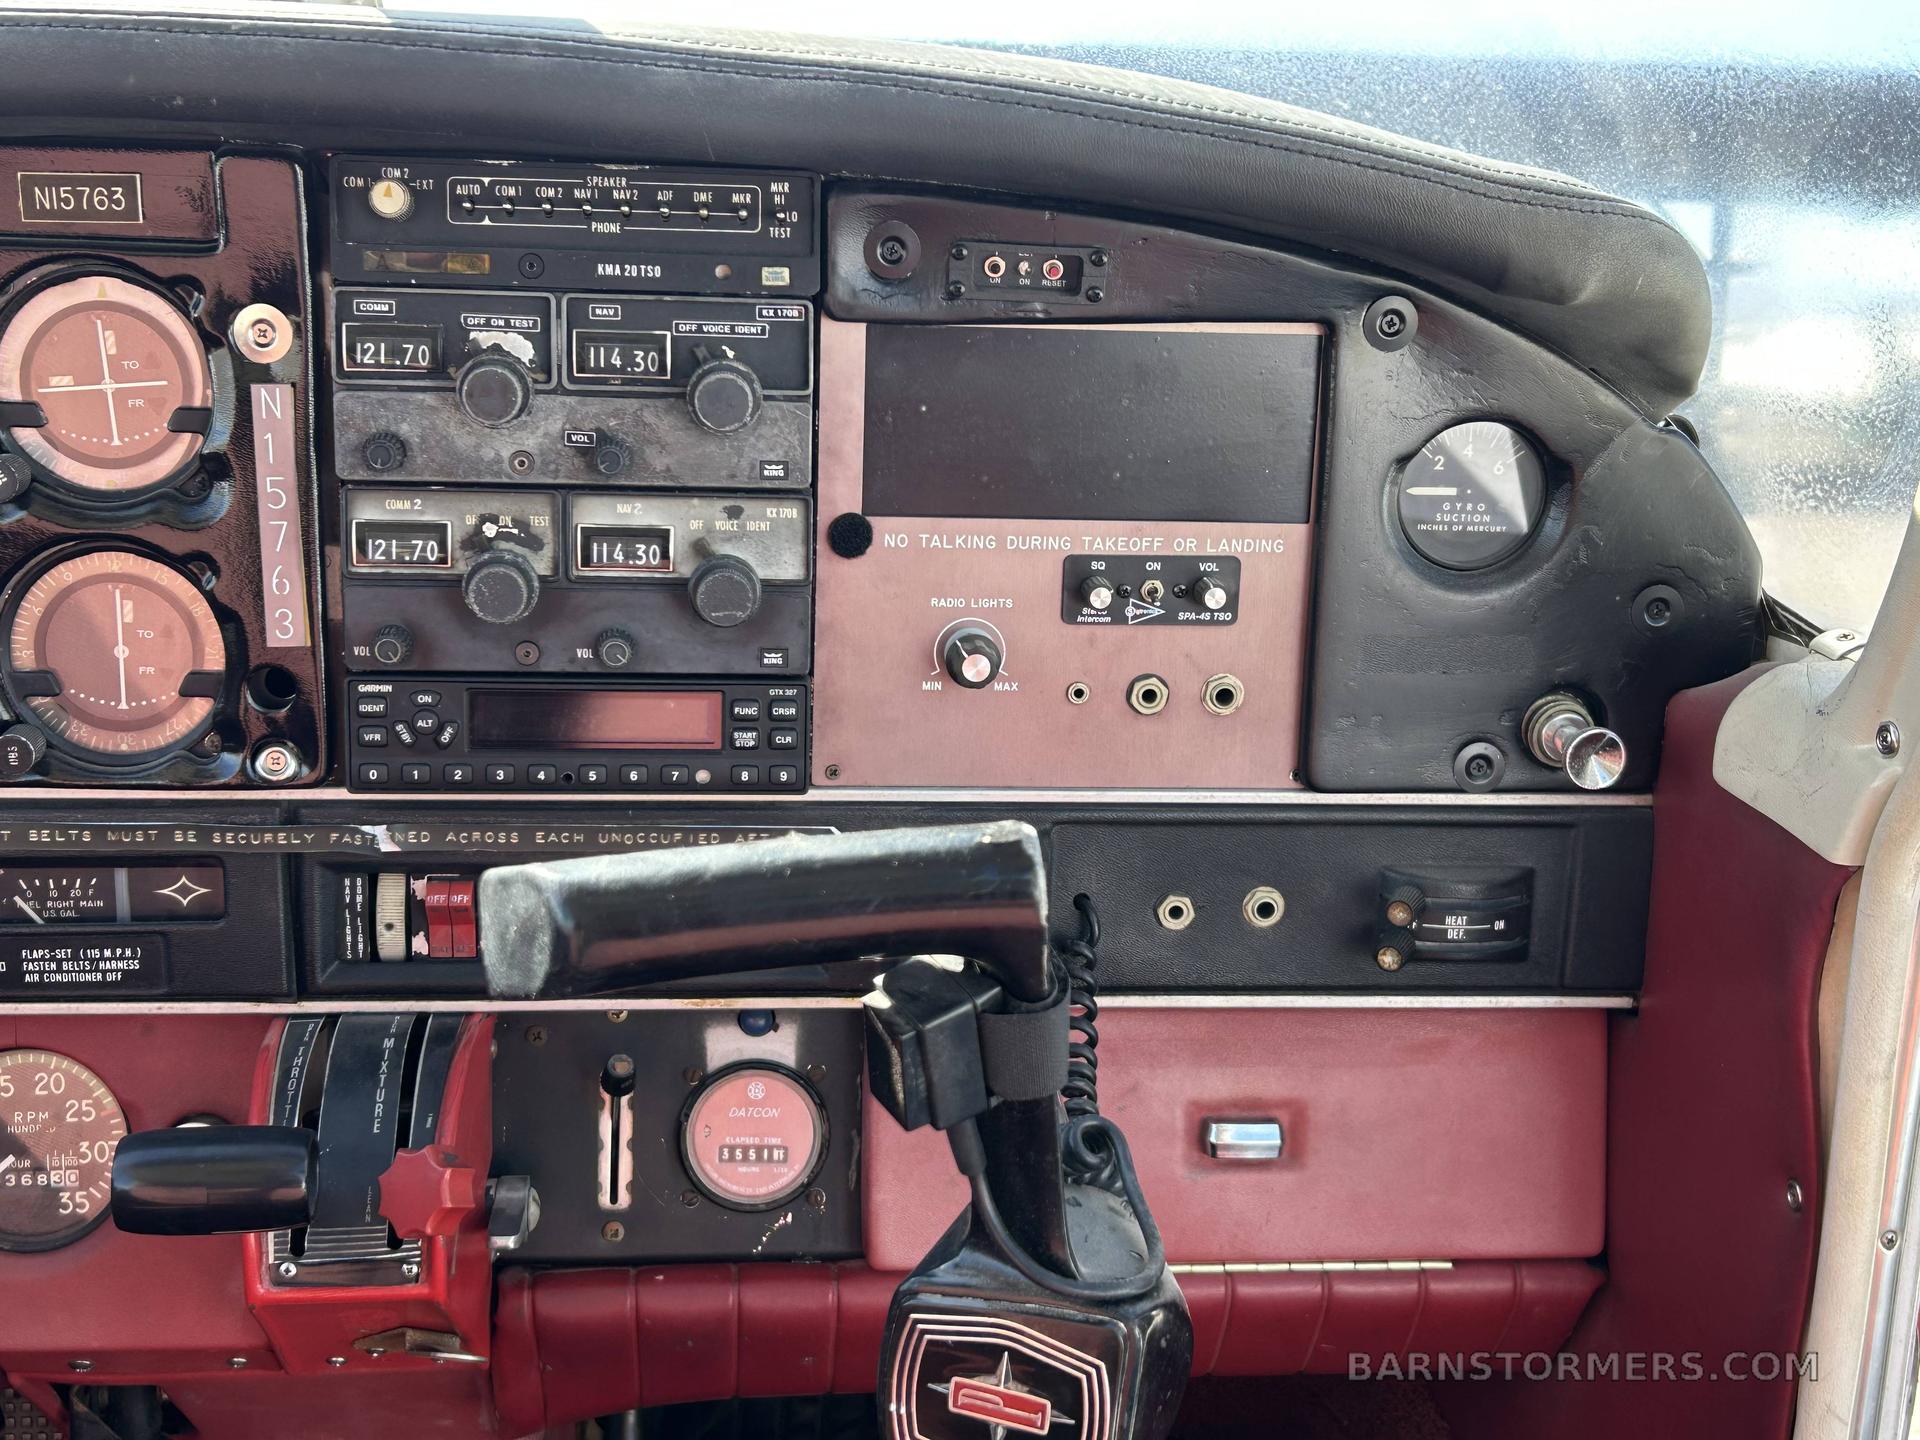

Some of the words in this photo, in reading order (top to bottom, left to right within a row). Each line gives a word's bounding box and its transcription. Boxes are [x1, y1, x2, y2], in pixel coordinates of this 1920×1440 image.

[382, 168, 400, 178] COM
[404, 168, 409, 178] 2
[344, 177, 364, 187] COM
[417, 180, 434, 190] EXT
[587, 177, 627, 188] SPEAKER
[456, 185, 481, 195] AUTO
[496, 186, 516, 197] COM
[518, 186, 522, 197] 1
[535, 187, 556, 198] COM
[558, 187, 563, 198] 2
[771, 183, 790, 193] MKR
[35, 187, 125, 210] N15763
[574, 188, 593, 199] NAV
[613, 189, 632, 200] NAV
[633, 190, 638, 200] 2
[657, 190, 673, 201] ADF
[694, 192, 712, 203] DME
[732, 193, 751, 204] MKR
[774, 194, 785, 205] HI
[787, 211, 798, 223] LO
[591, 222, 621, 233] PHONE
[770, 228, 791, 238] TEST
[598, 264, 621, 276] KMA
[624, 265, 637, 277] 20
[640, 265, 661, 277] TSO
[596, 308, 615, 316] NAV
[762, 309, 774, 317] KX
[778, 309, 799, 318] 170B
[468, 317, 486, 325] OFF
[491, 319, 504, 327] ON
[510, 319, 534, 328] TEST
[679, 324, 697, 332] OFF
[702, 325, 730, 333] VOICE
[735, 326, 762, 334] IDENT
[357, 343, 430, 365] 121.70
[590, 347, 659, 372] 114.30
[121, 361, 139, 369] TO
[128, 399, 144, 407] FR
[572, 434, 590, 443] VOL
[1464, 444, 1473, 457] 4
[1434, 456, 1444, 470] 2
[1494, 461, 1504, 475] 6
[764, 469, 784, 477] KING
[386, 500, 411, 510] COMM
[414, 500, 422, 510] 2
[617, 504, 632, 514] NAV
[1443, 503, 1485, 511] GYRO
[767, 508, 777, 517] KX
[780, 508, 797, 518] 170B
[1436, 513, 1490, 522] SUCTION
[466, 515, 480, 526] OF
[530, 516, 549, 527] TEST
[690, 520, 704, 530] OFF
[715, 521, 738, 531] VOICE
[747, 522, 771, 532] IDENT
[884, 534, 908, 548] NO
[919, 534, 996, 550] TALKING
[1007, 536, 1071, 551] DURING
[1082, 536, 1164, 552] TAKEOFF
[1174, 538, 1197, 553] OR
[1207, 538, 1284, 554] LANDING
[368, 539, 438, 561] 121.70
[593, 542, 660, 565] 114.30
[1091, 561, 1106, 570] SQ
[1146, 562, 1161, 571] ON
[1200, 563, 1219, 571] VOL
[931, 597, 966, 608] RADIO
[971, 598, 1014, 609] LIGHTS
[1077, 615, 1111, 623] Intercom
[136, 630, 154, 638] TO
[354, 647, 370, 657] VOL
[577, 649, 593, 658] VOL
[139, 667, 155, 675] FR
[922, 681, 942, 691] MIN
[994, 681, 1019, 692] MAX
[418, 695, 432, 703] ON
[417, 720, 433, 728] ALT
[395, 723, 413, 745] STBY
[441, 726, 454, 744] OFF
[776, 736, 792, 744] CLR
[369, 770, 377, 780] 0
[412, 770, 418, 780] 1
[454, 770, 462, 780] 2
[497, 770, 504, 780] 3
[537, 770, 545, 780] 4
[589, 772, 596, 781] 5
[630, 772, 638, 781] 6
[672, 772, 679, 781] 7
[741, 772, 749, 781] 8
[780, 772, 787, 781] 9
[29, 830, 92, 842] BELTS
[107, 831, 158, 842] MUST
[175, 831, 197, 843] BE
[212, 831, 315, 844] SECURELY
[445, 832, 520, 843] ACROSS
[536, 832, 584, 843] EACH
[598, 833, 720, 844] UNOCCUPIED
[1446, 916, 1467, 925] HEAT
[1495, 920, 1504, 930] ON
[1448, 929, 1466, 939] DEF.
[22, 949, 72, 959] FLAPS-SET
[24, 961, 56, 971] FASTEN
[25, 974, 40, 983] AIR
[44, 973, 102, 982] CONDITIONER
[107, 972, 122, 982] OFF
[35, 1073, 65, 1095] 20
[283, 1047, 305, 1126] THROTT
[373, 1038, 395, 1133] MIXTURE
[65, 1100, 96, 1122] 25
[729, 1107, 781, 1118] DATCON
[15, 1112, 49, 1123] RPM
[79, 1141, 110, 1164] 30
[59, 1192, 90, 1214] 35
